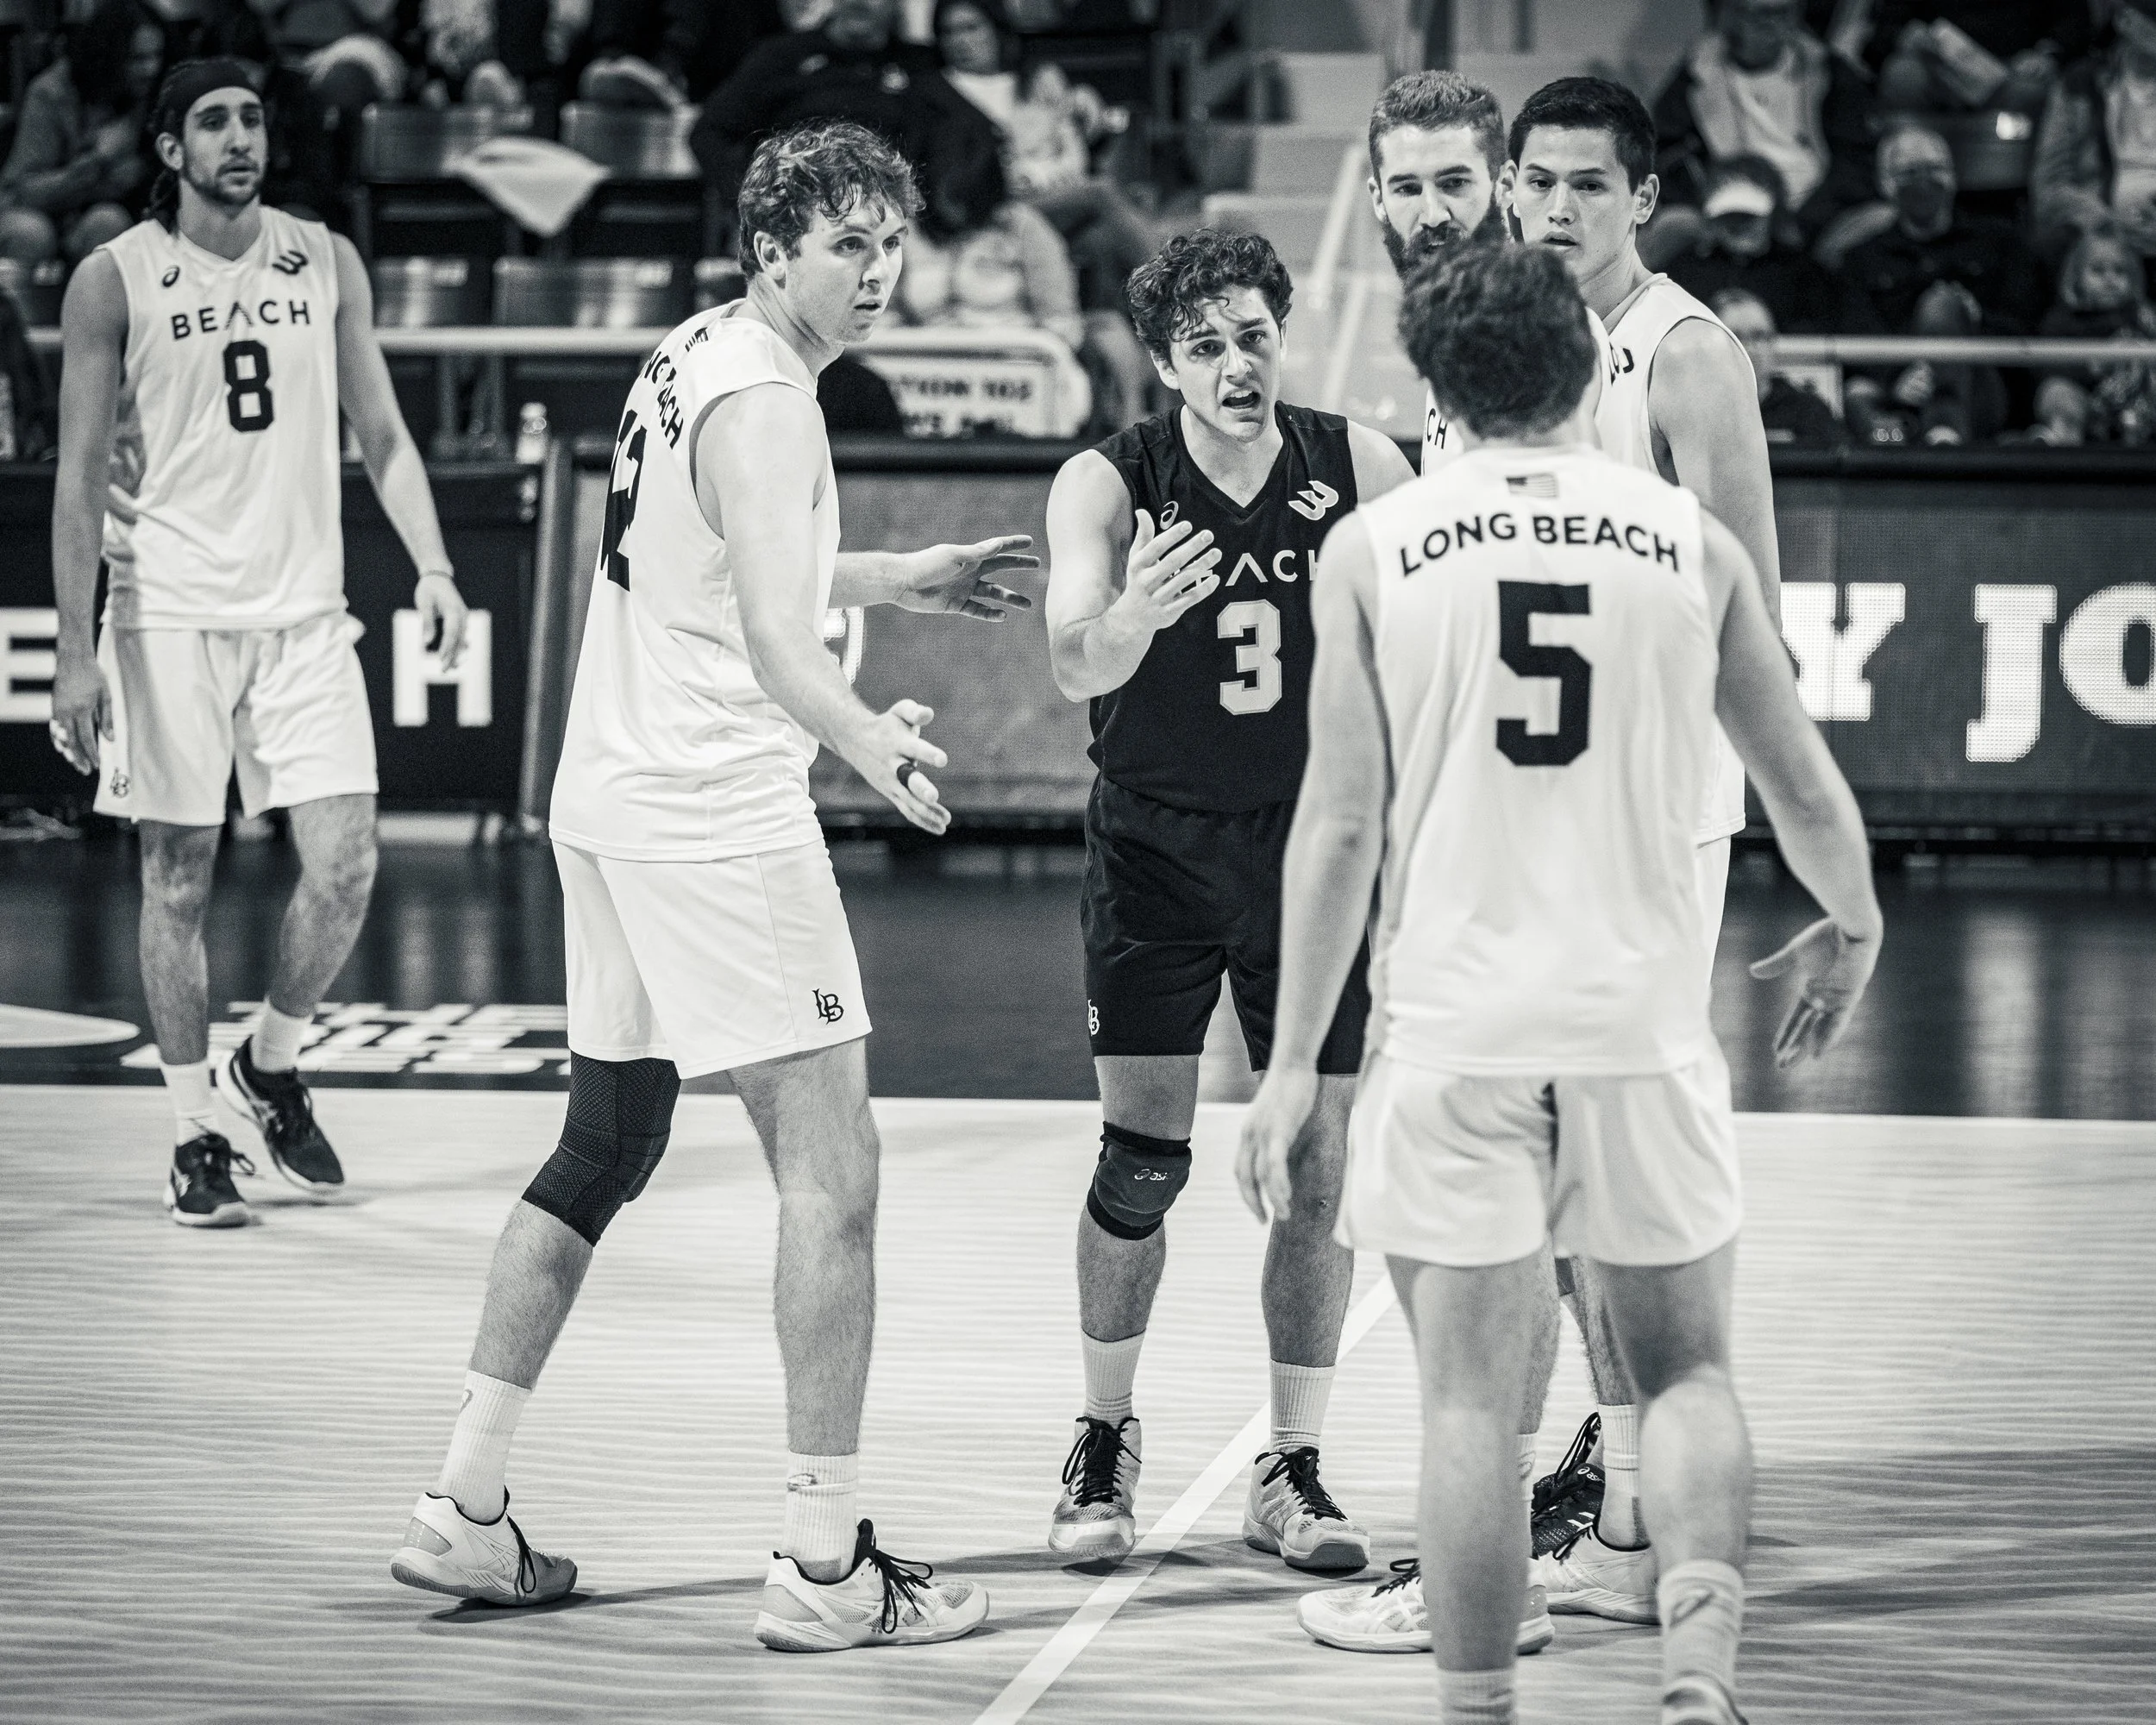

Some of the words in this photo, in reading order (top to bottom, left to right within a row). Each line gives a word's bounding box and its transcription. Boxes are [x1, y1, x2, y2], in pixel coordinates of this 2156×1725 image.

[172, 300, 310, 340] BEACH
[223, 340, 274, 433] 8
[1401, 513, 1518, 577] LONG
[1532, 516, 1680, 573] BEACH
[1217, 599, 1282, 715] 3
[1496, 580, 1592, 766] 5
